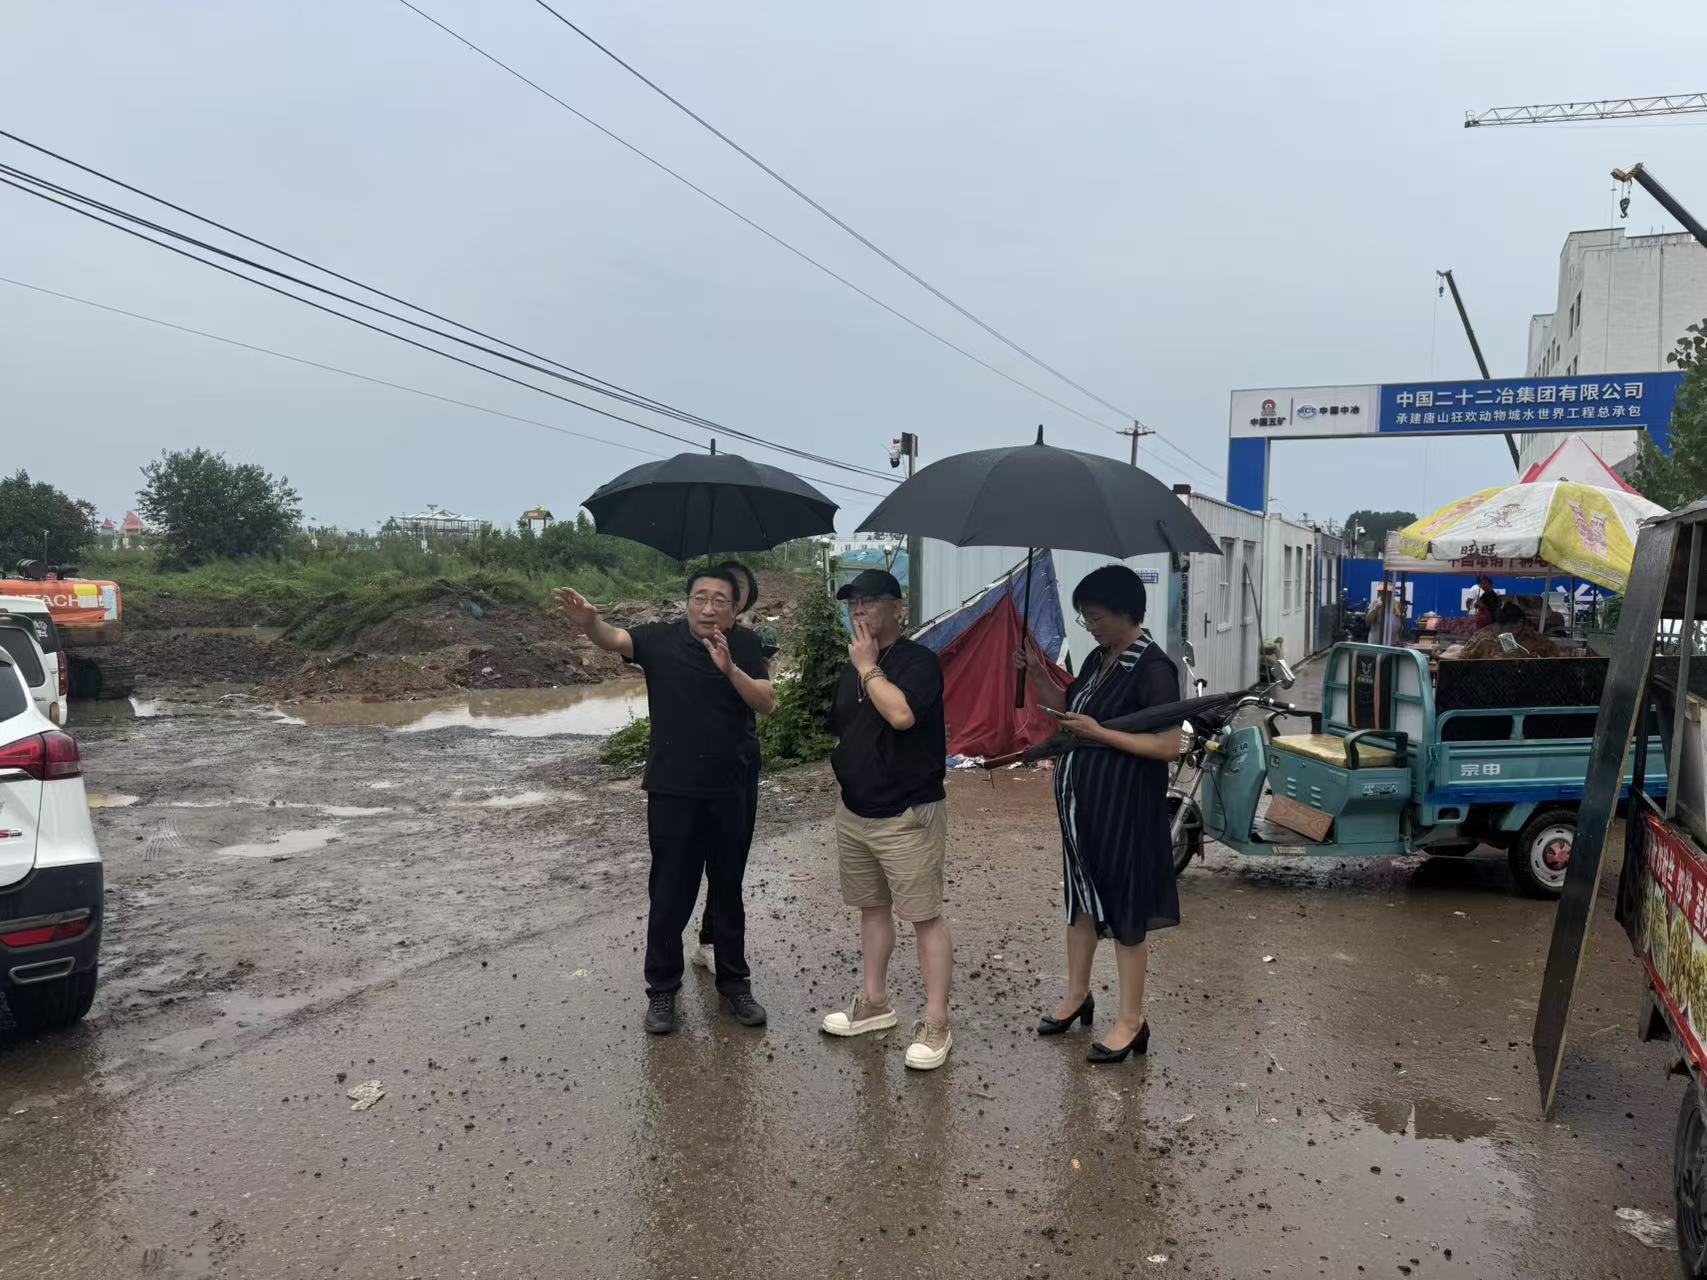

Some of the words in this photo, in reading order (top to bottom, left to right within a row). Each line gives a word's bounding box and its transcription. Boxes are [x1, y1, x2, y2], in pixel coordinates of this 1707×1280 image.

[1396, 381, 1644, 408] 中国二十二冶集团有限公司
[1319, 405, 1360, 416] 中国中冶
[1396, 404, 1641, 425] 承建唐山狂欢动物城水世界工程总承包
[1250, 417, 1287, 428] 中国五矿
[1461, 763, 1500, 776] 宗申
